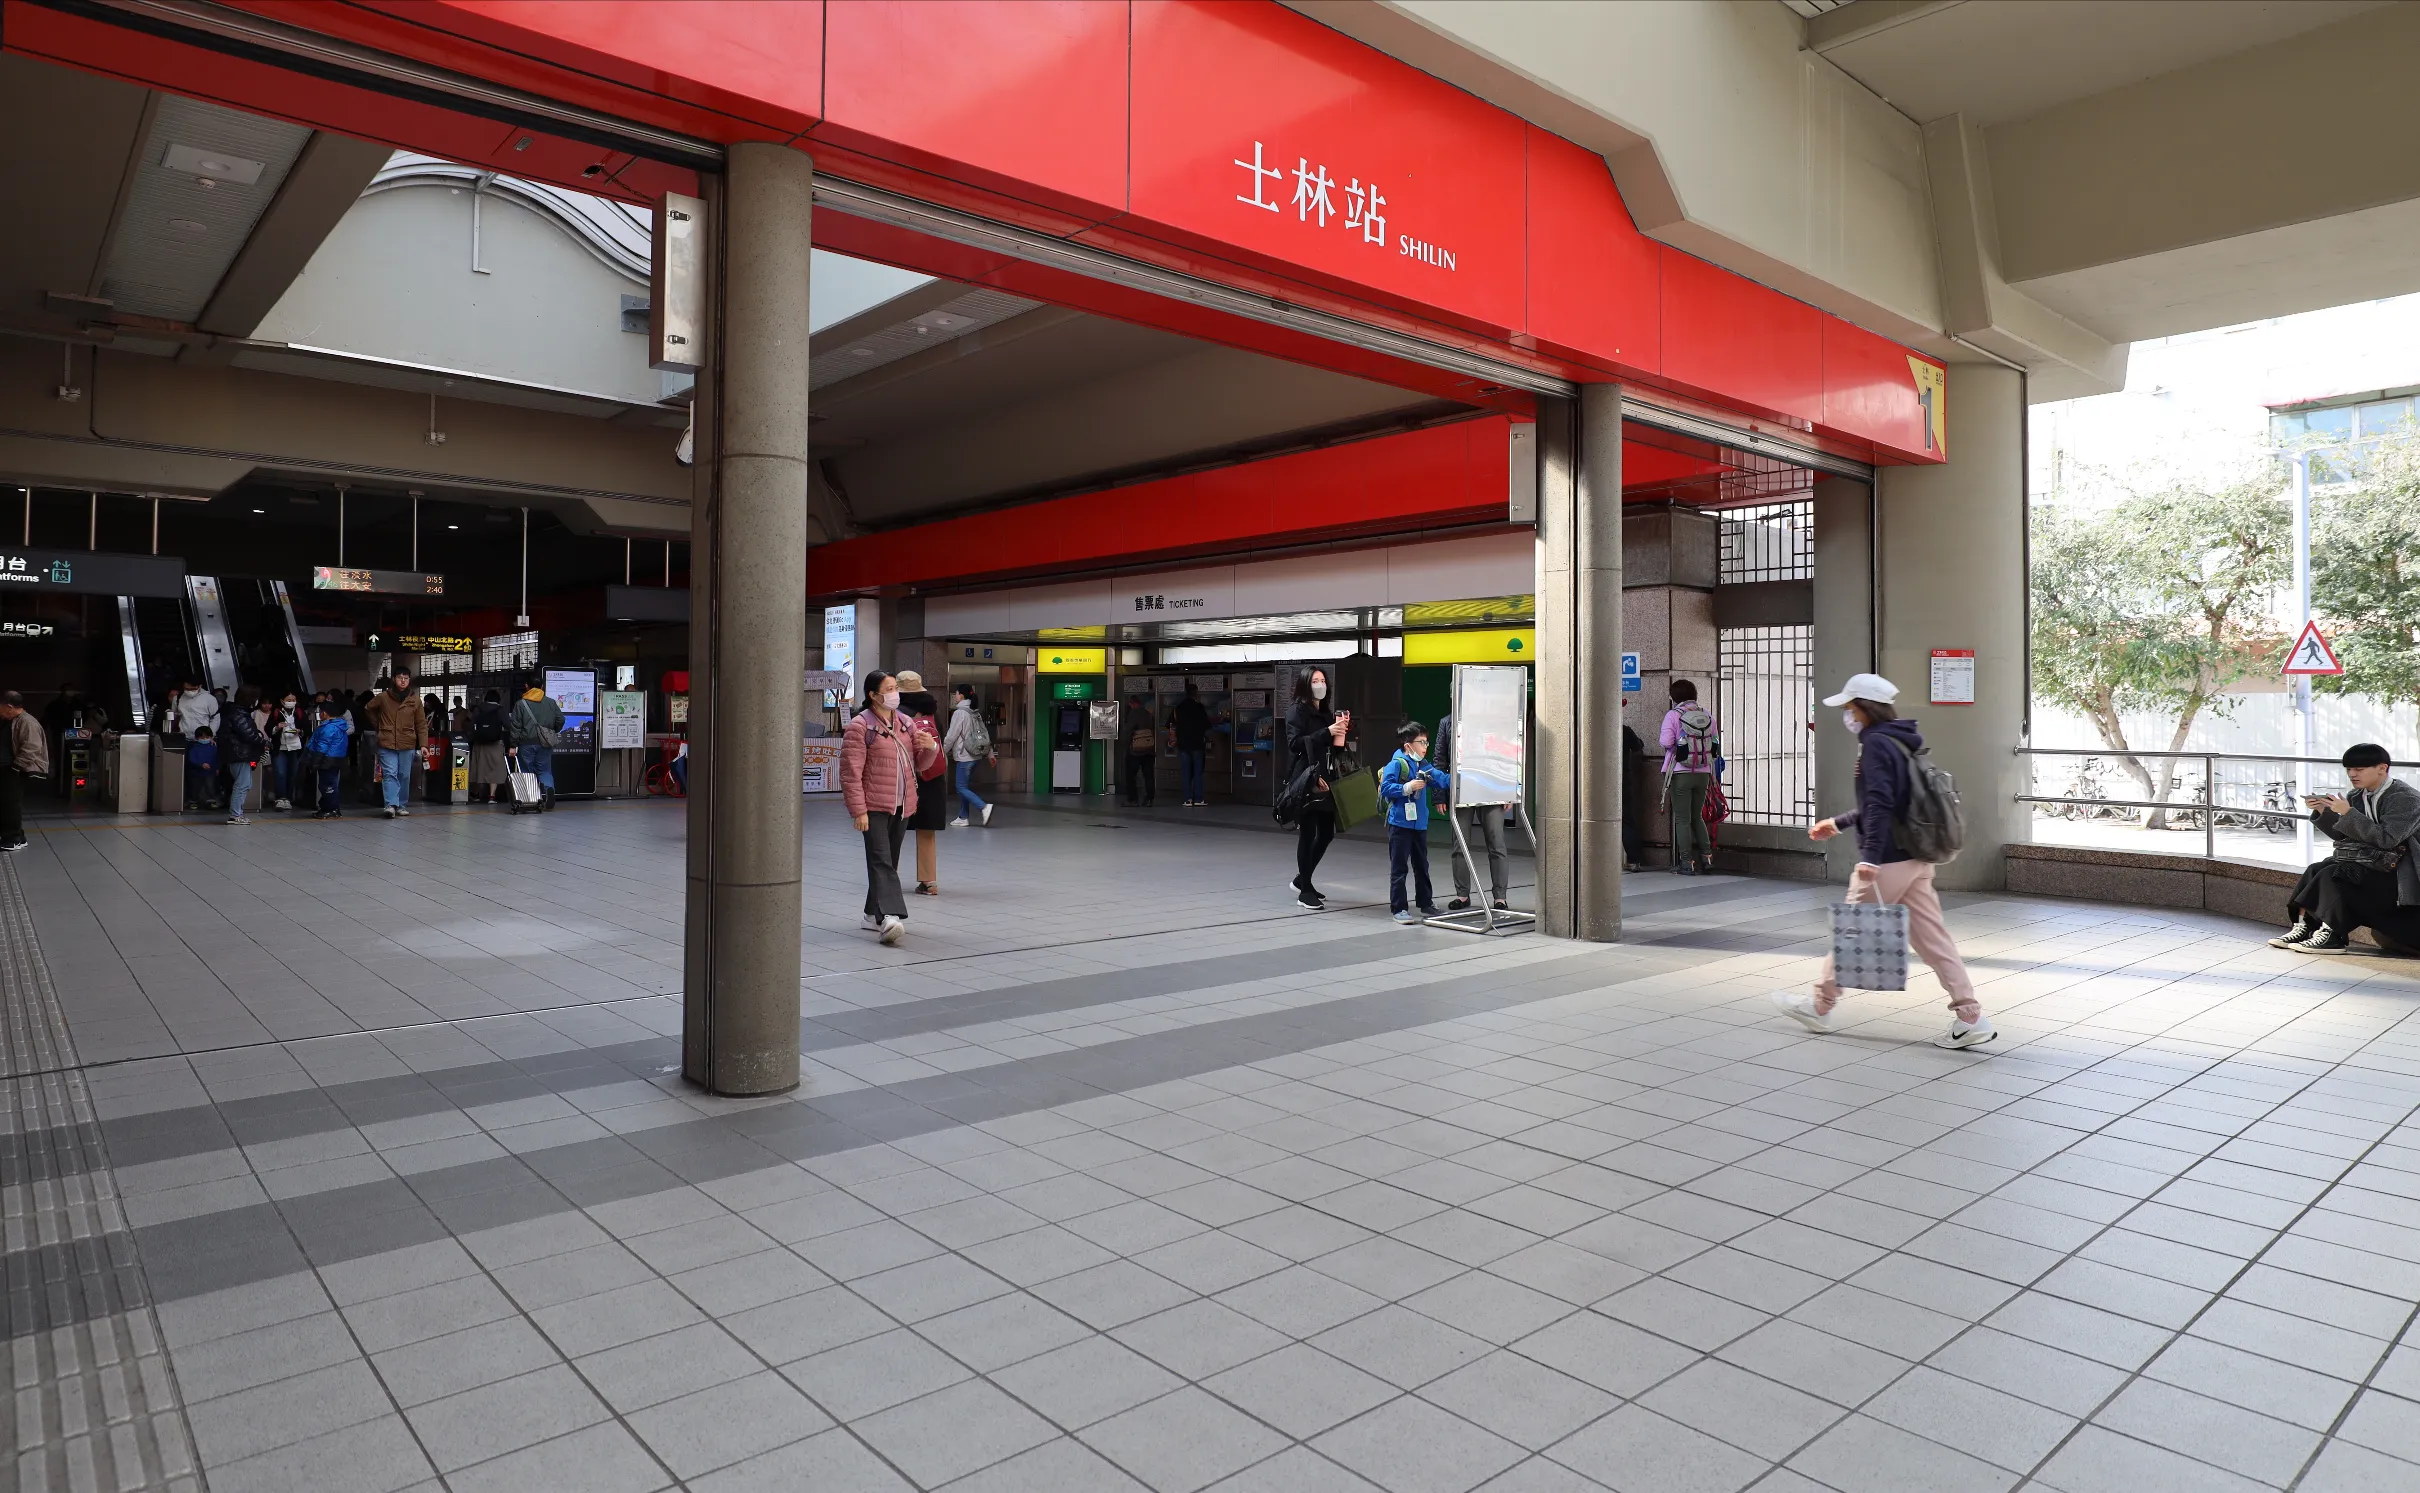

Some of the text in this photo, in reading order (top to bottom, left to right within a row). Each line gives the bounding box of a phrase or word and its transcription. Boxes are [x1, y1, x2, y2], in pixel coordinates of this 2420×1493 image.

[1234, 140, 1387, 247] 士林站
[1399, 234, 1456, 272] SHILIN
[0, 556, 27, 572] 台
[340, 580, 372, 591] 往大安
[425, 575, 443, 584] 0:55
[426, 586, 443, 594] 2:40
[1135, 595, 1164, 611] 售票處
[1169, 599, 1204, 609] TICKETING
[3, 622, 26, 632] 月台
[454, 638, 464, 651] 2
